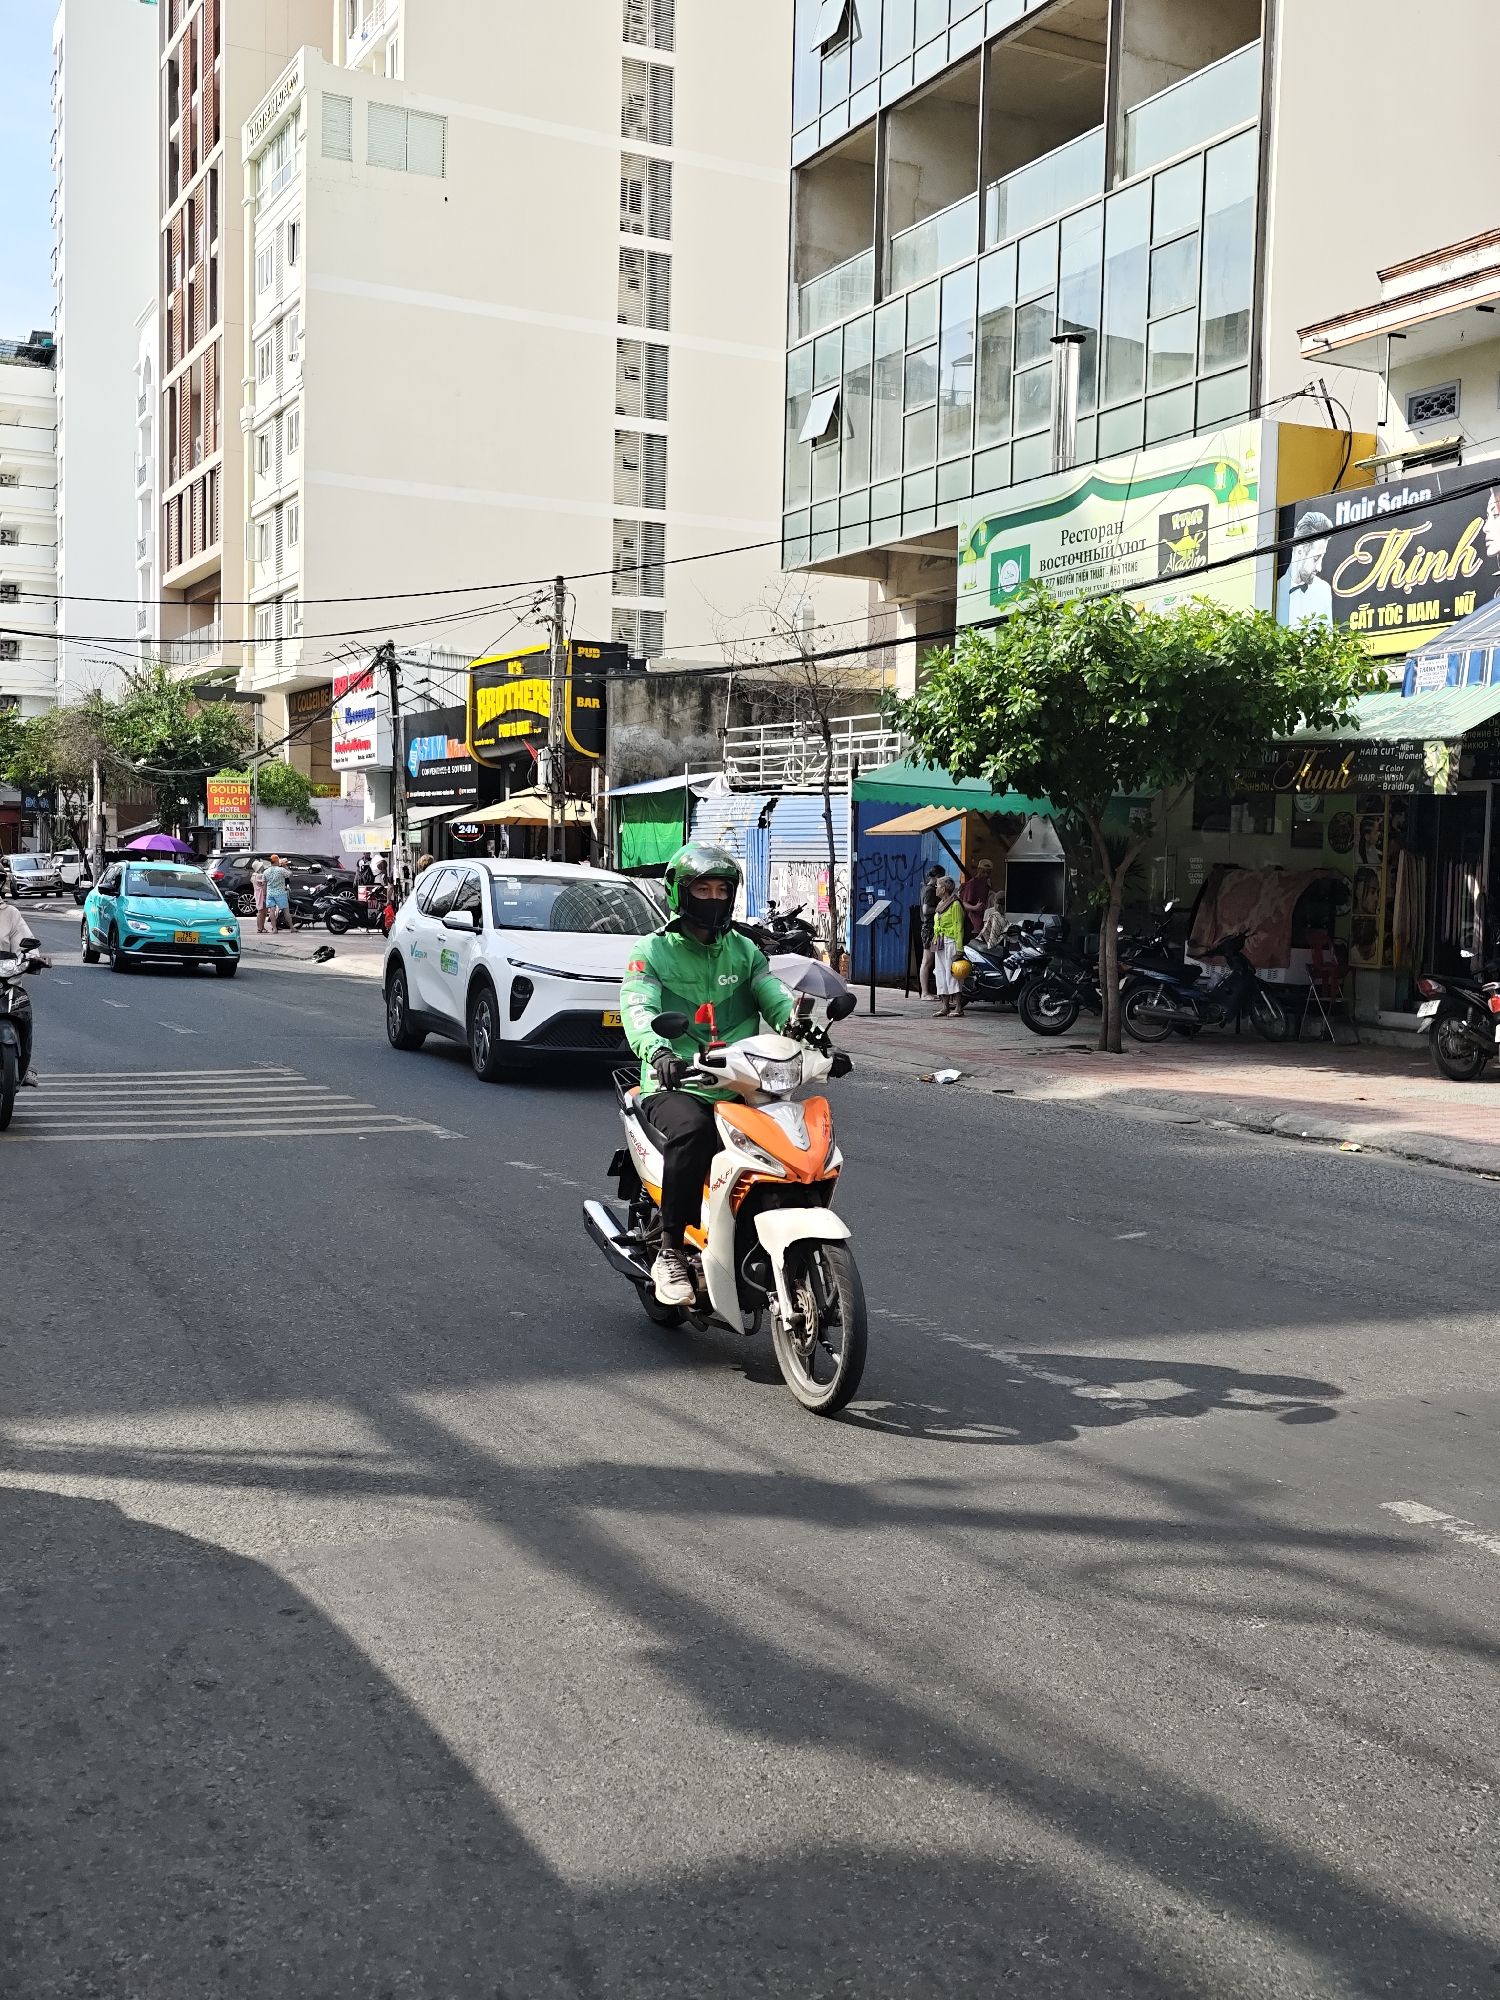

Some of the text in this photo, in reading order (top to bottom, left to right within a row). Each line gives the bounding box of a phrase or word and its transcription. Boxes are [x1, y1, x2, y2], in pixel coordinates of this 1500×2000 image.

[1336, 486, 1432, 527] Hair Salon
[1060, 520, 1124, 547] Ресторан
[1039, 538, 1147, 572] восточный уют
[1332, 516, 1484, 597] Thịnh
[1350, 602, 1375, 630] CẮT
[1406, 599, 1440, 624] NAM
[1454, 590, 1477, 617] NỮ
[577, 646, 601, 659] PUB
[476, 678, 551, 730] BROTHERS
[576, 696, 601, 709] BAR
[1359, 747, 1396, 756] HAIR CUT
[1357, 773, 1376, 782] HAIR
[209, 785, 250, 794] GOLDEN
[213, 796, 247, 806] BEACH
[457, 824, 479, 834] 24h
[349, 832, 366, 845] SANA
